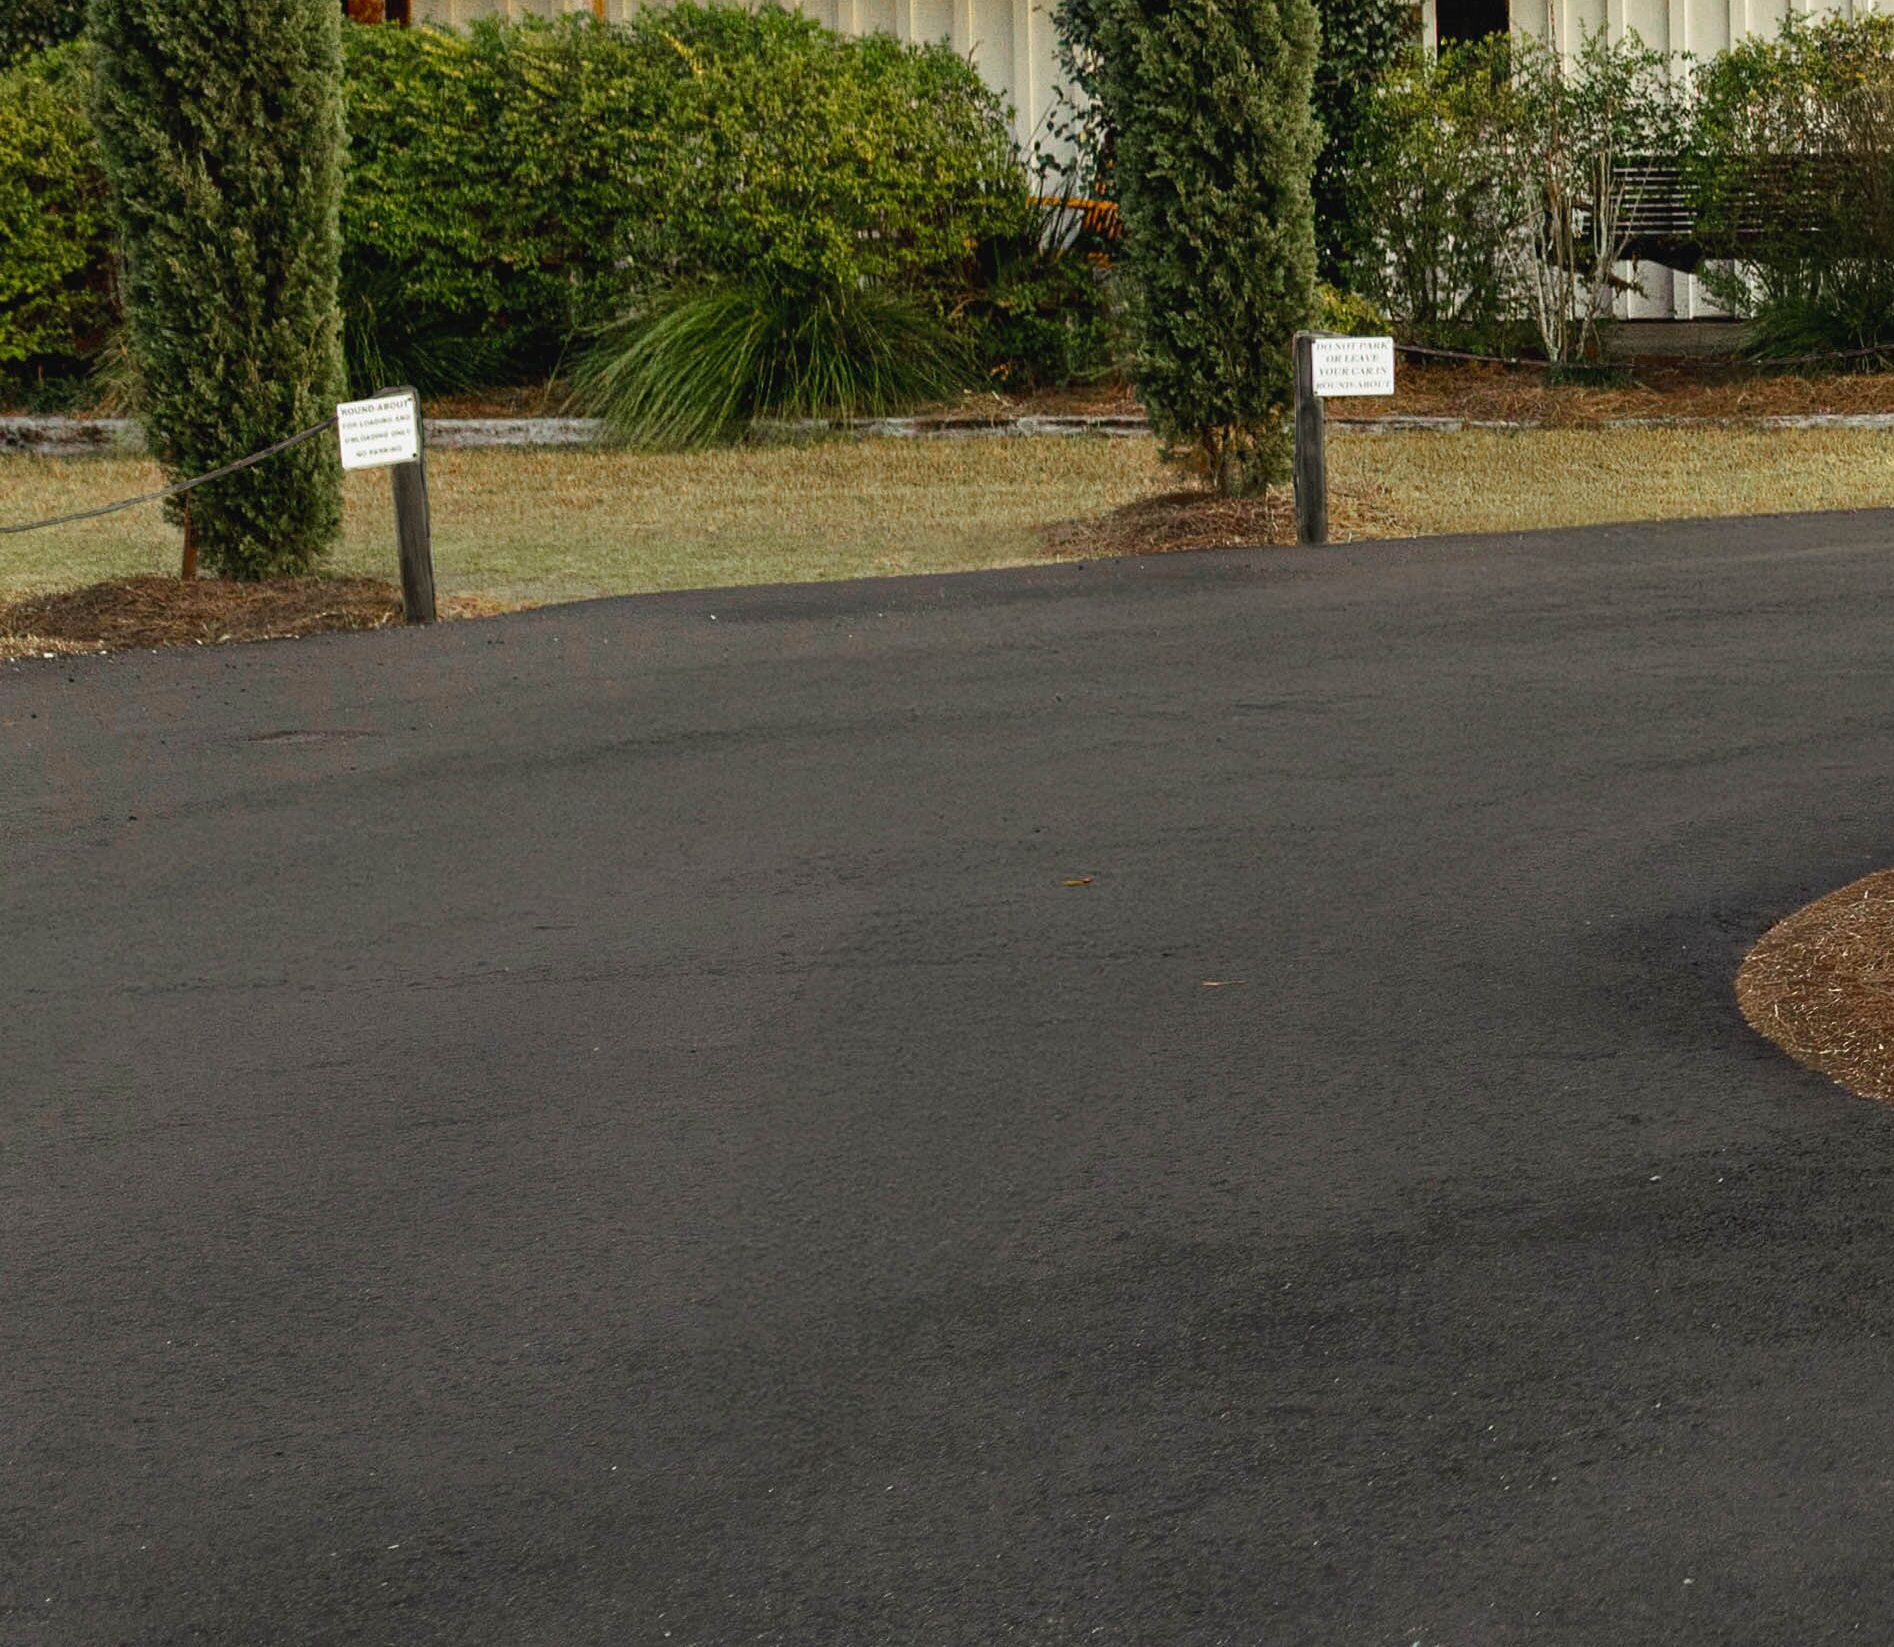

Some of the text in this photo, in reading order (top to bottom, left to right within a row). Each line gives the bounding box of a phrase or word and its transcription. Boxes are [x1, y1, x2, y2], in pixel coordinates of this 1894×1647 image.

[1316, 341, 1388, 351] DO NOT PARK
[1325, 354, 1379, 363] OR LEAVE
[1319, 367, 1349, 376] YOUR
